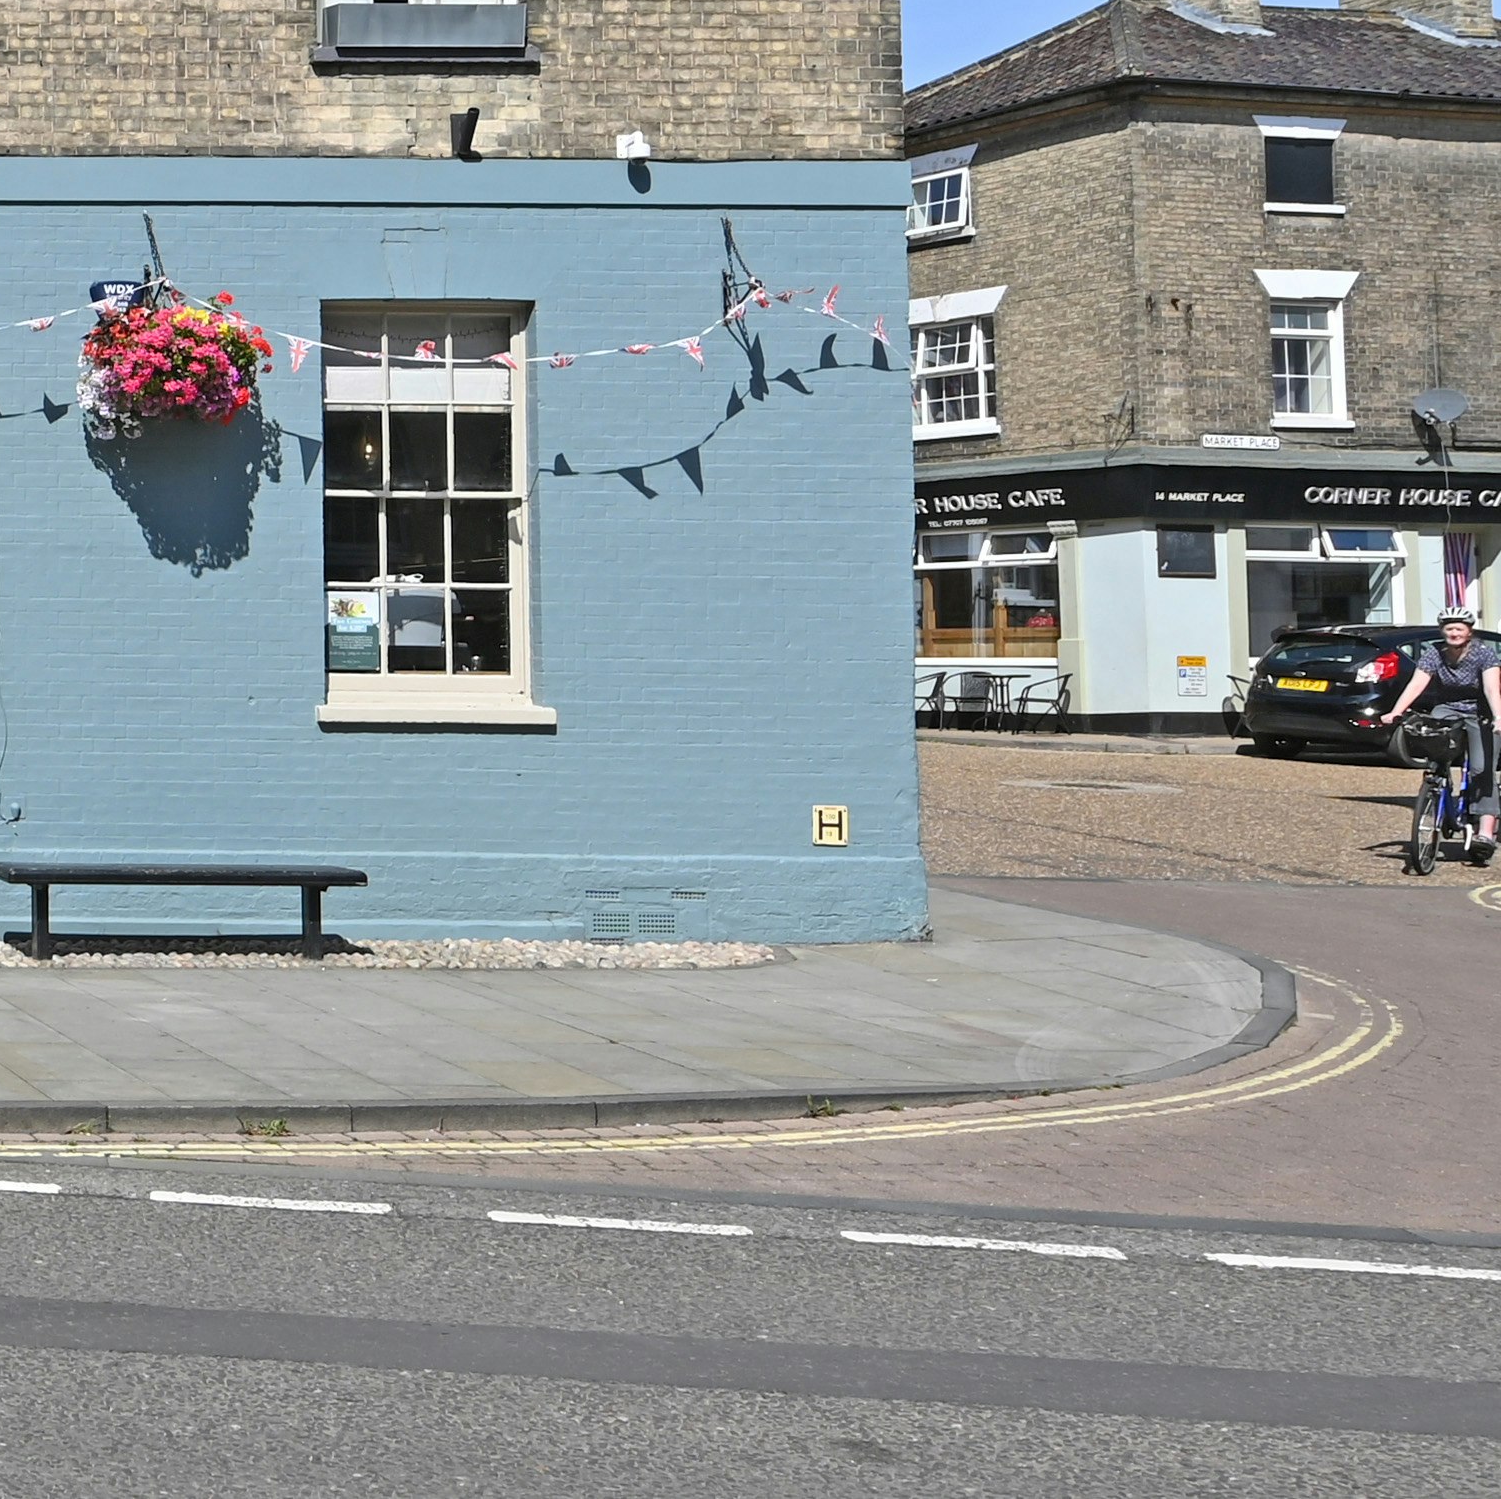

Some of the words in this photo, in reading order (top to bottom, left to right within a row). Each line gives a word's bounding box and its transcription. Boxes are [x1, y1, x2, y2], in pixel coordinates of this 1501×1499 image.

[103, 283, 135, 295] WDX
[1204, 436, 1244, 447] MARKET
[1249, 437, 1278, 448] PLACE
[1155, 492, 1165, 501] 14
[1168, 492, 1210, 502] MARKET
[1212, 493, 1245, 503] PLACE
[1304, 486, 1392, 505] CORNER
[1398, 488, 1472, 507] HOUSE
[818, 809, 843, 841] H
